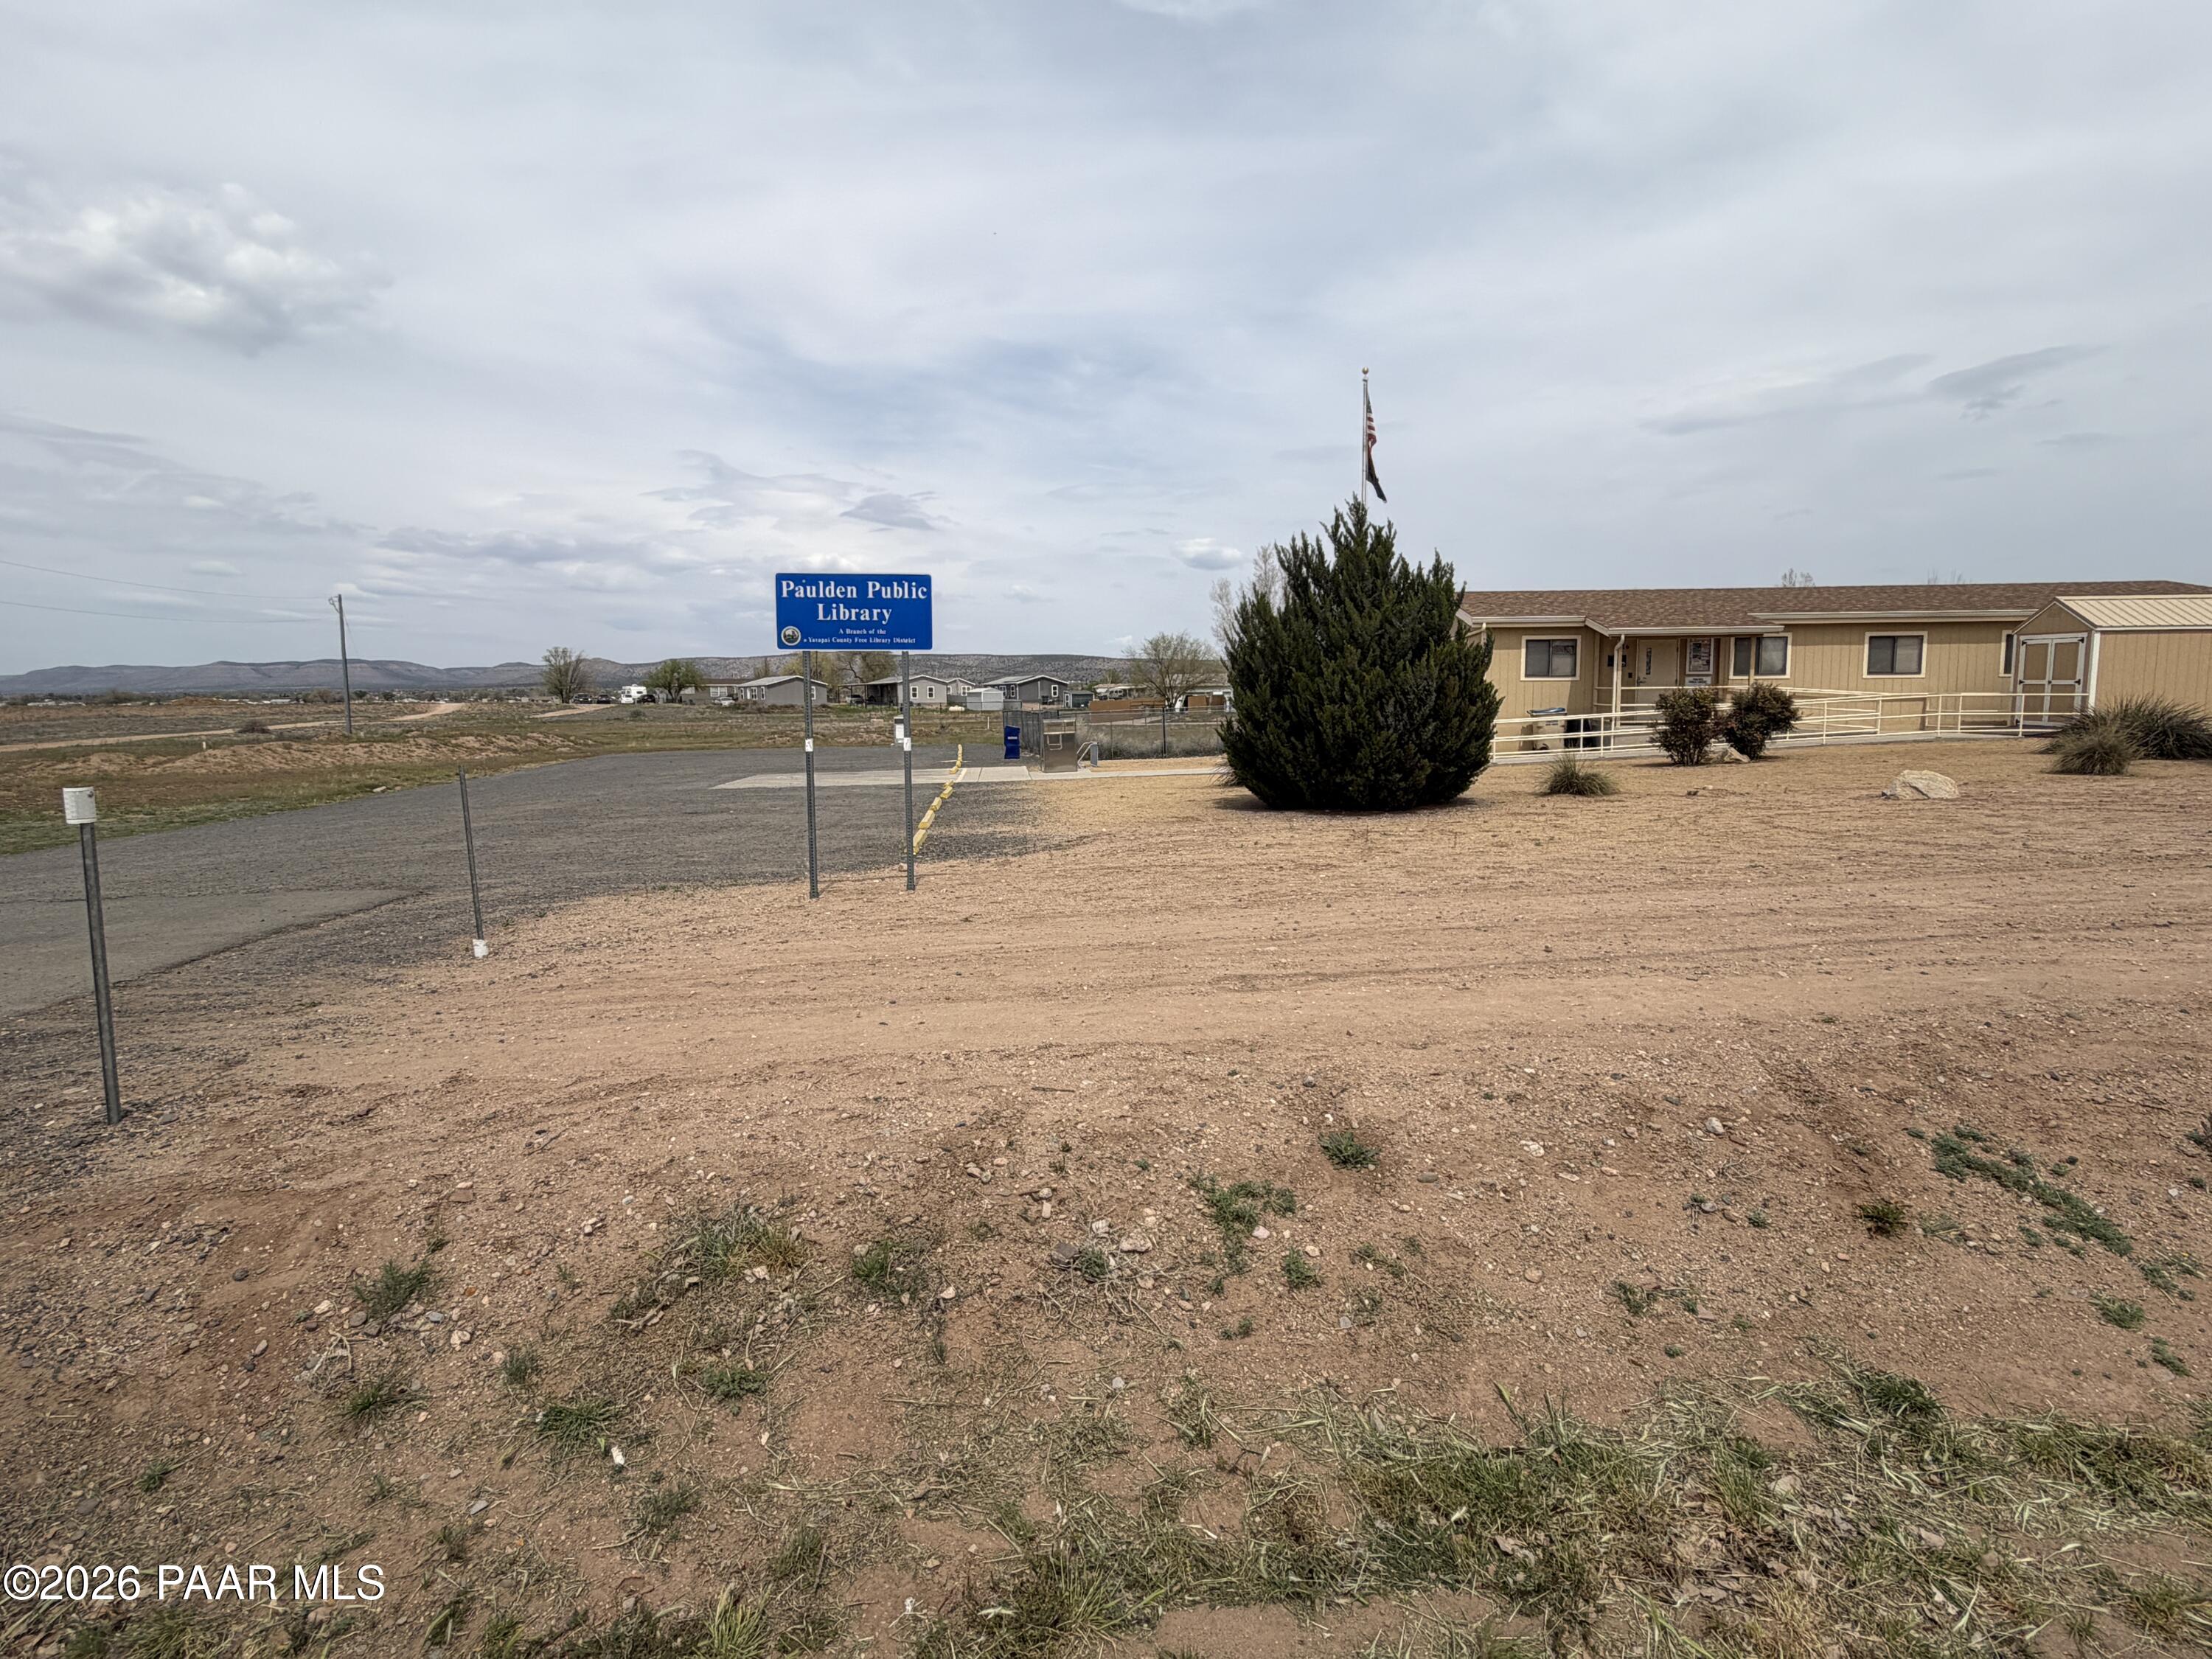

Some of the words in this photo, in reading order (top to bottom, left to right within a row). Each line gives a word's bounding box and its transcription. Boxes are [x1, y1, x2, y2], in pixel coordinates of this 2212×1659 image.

[781, 580, 858, 598] Paulden
[867, 581, 928, 599] Public
[817, 603, 892, 625] Library
